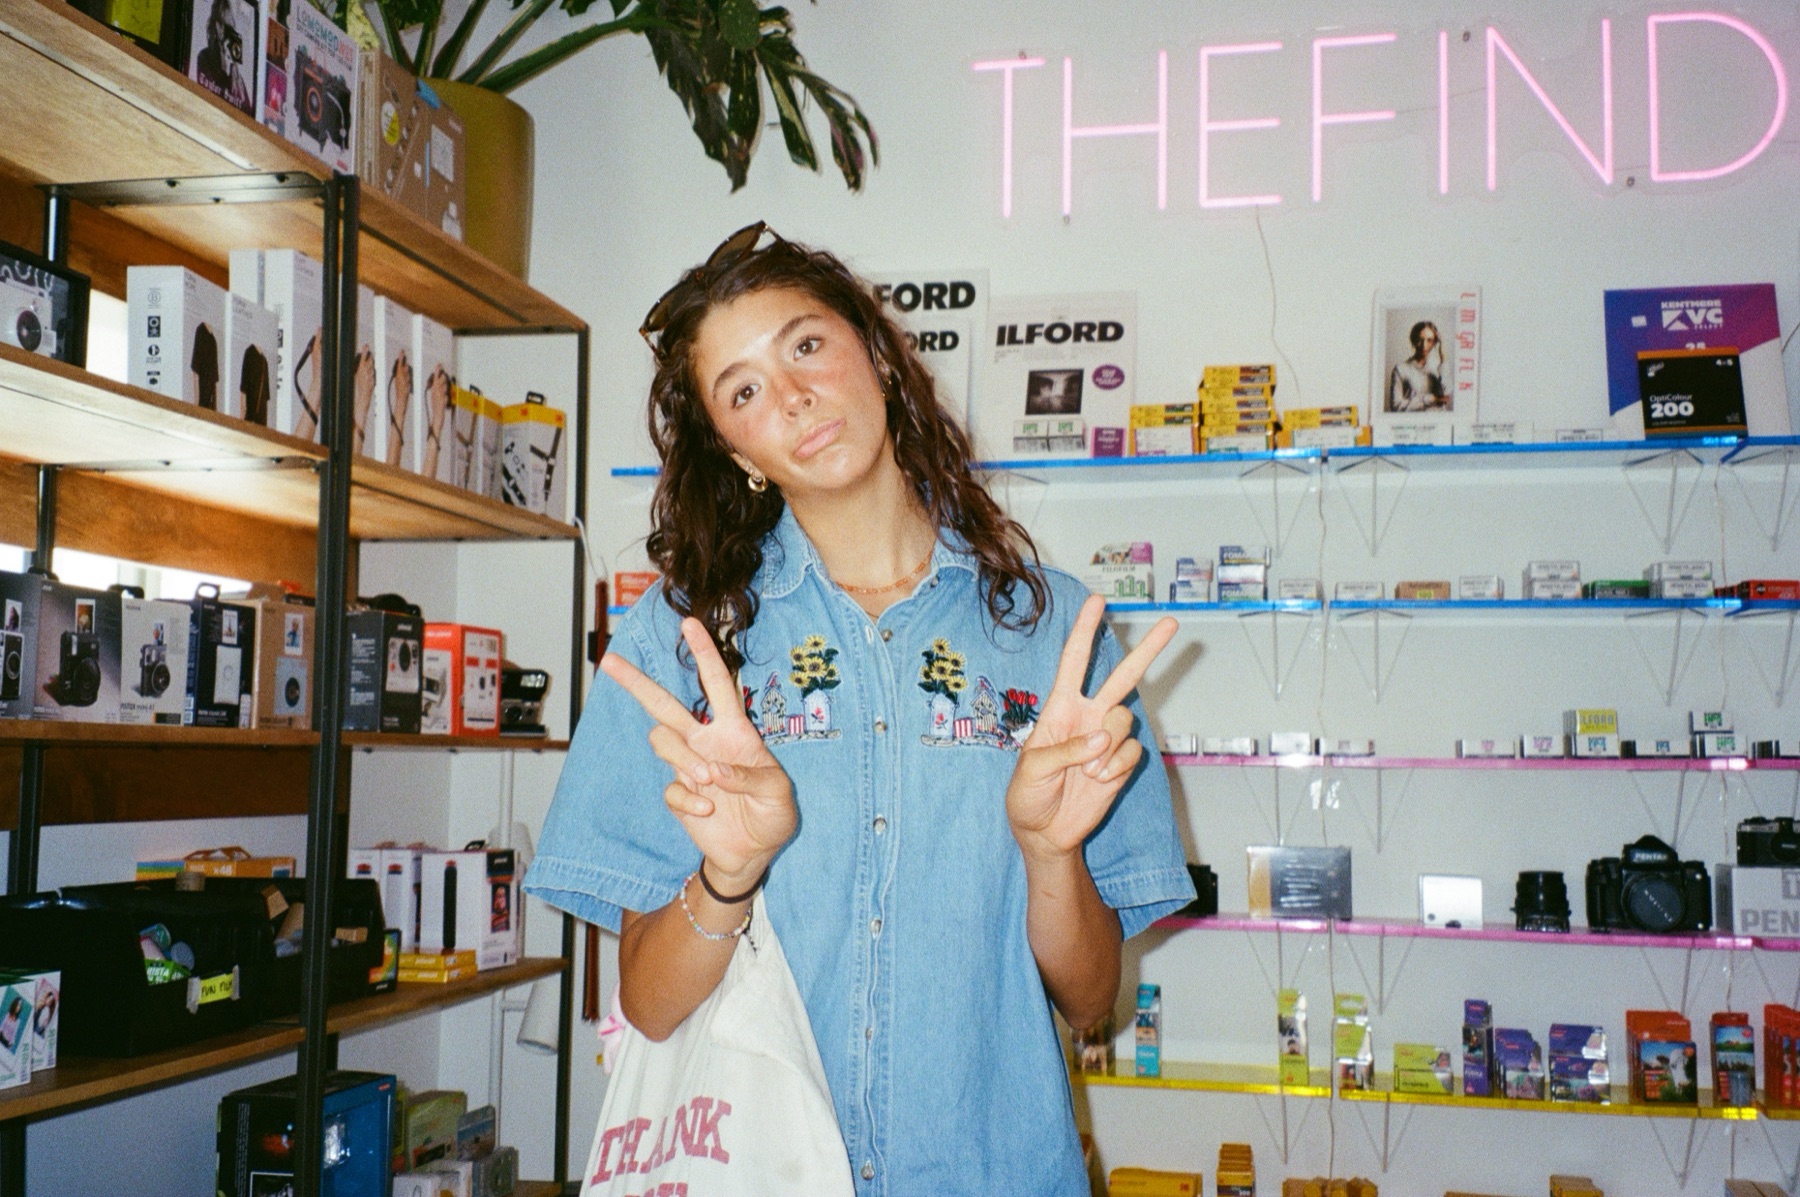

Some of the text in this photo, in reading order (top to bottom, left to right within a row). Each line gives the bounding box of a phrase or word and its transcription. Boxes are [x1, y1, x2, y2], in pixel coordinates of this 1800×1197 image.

[1660, 299, 1722, 309] KENTMERE
[1685, 308, 1724, 325] VC
[996, 321, 1125, 346] ILFORD
[1650, 392, 1693, 403] OptiColour
[1650, 402, 1695, 418] 200
[201, 985, 216, 997] FUN
[590, 1095, 732, 1187] THANK
